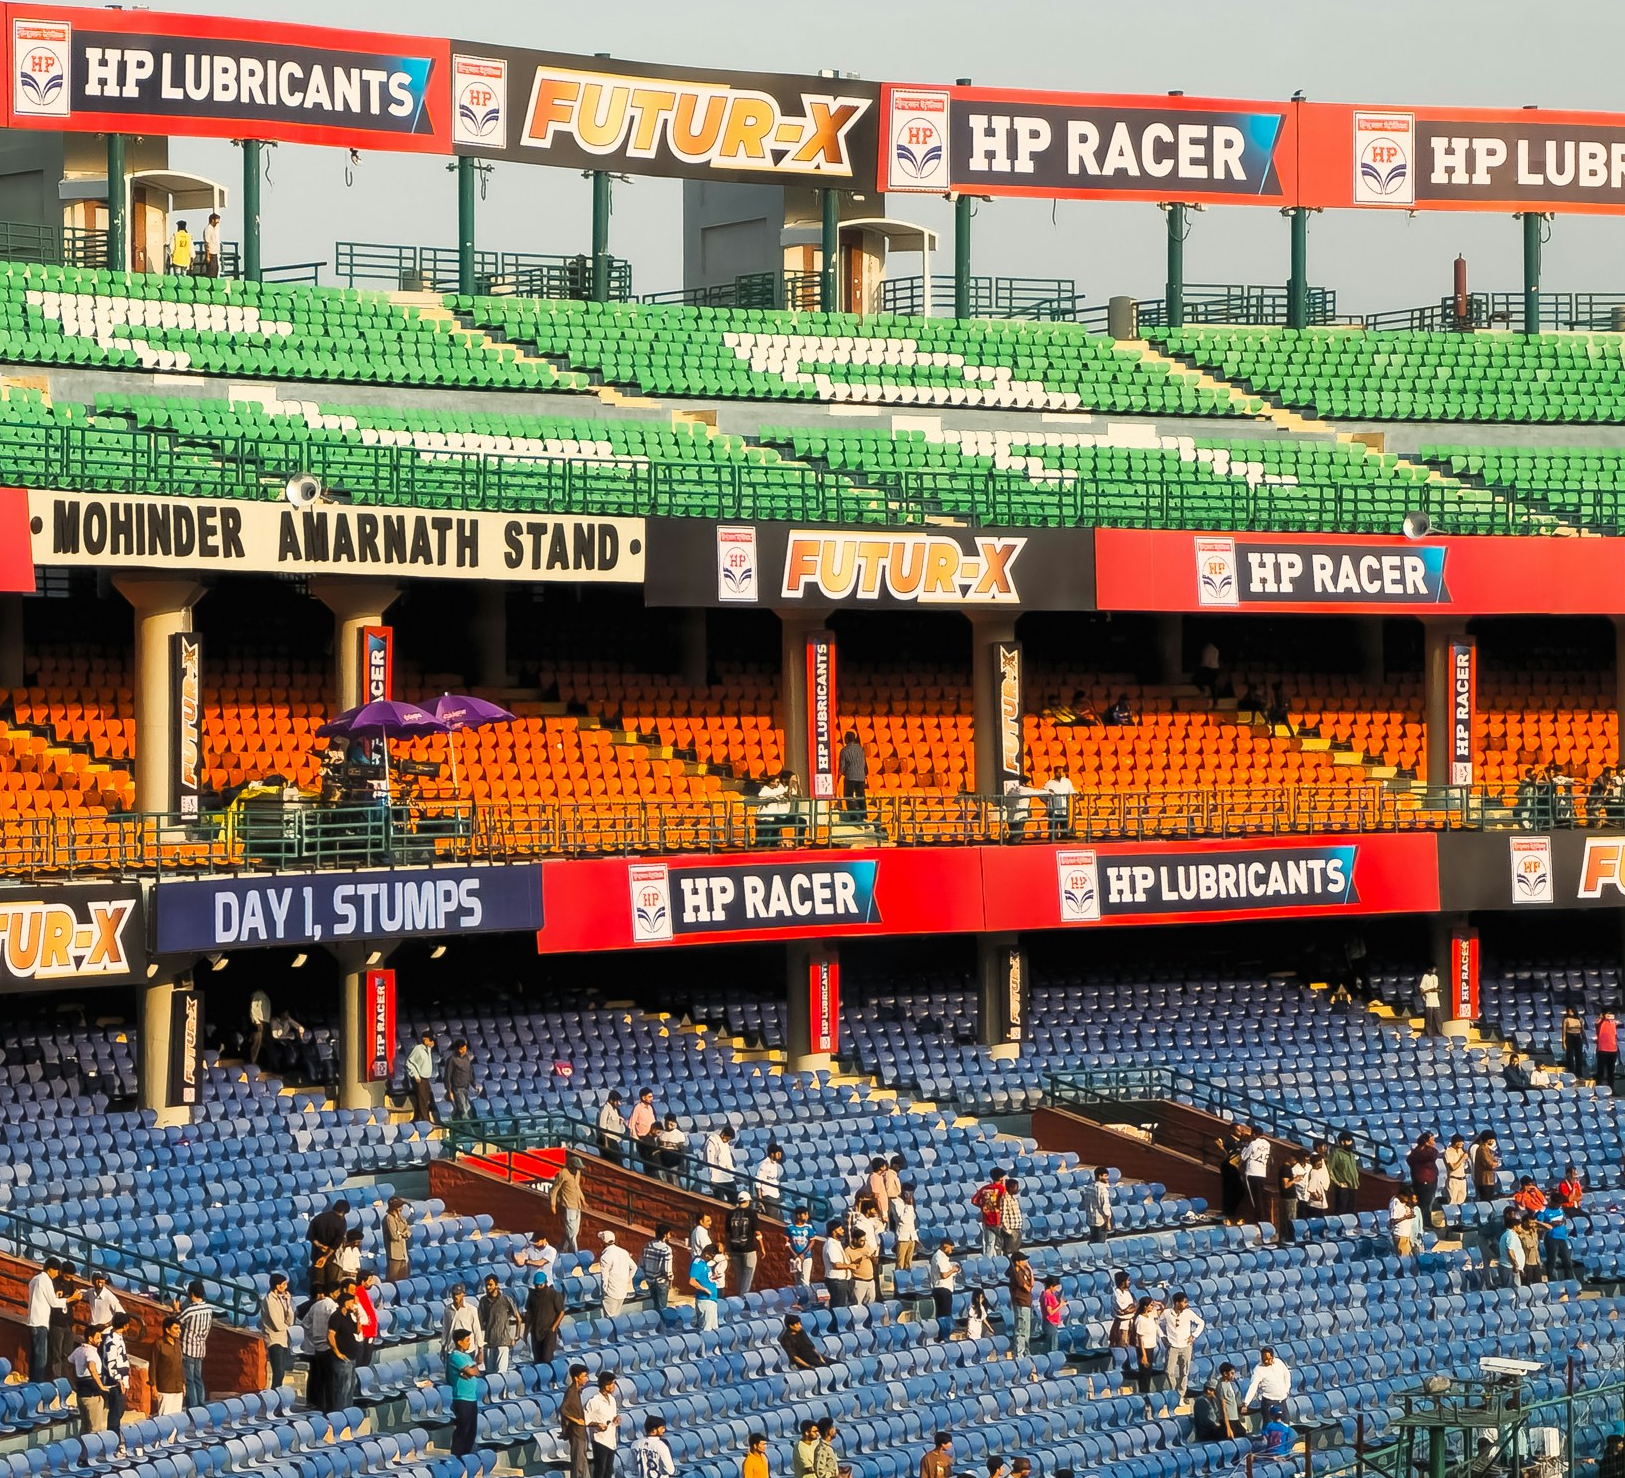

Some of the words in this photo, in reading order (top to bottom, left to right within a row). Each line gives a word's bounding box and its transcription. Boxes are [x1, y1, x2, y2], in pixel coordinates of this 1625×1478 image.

[31, 55, 55, 73] HP
[85, 47, 154, 98] HP
[161, 52, 414, 116] LUBRICANTS
[469, 89, 491, 107] HP
[525, 73, 865, 169] FUTUR-X
[908, 127, 933, 144] HP
[969, 114, 1051, 173] HP
[1067, 120, 1247, 181] RACER
[1430, 137, 1507, 186] HP
[53, 499, 245, 559] MOHINDER
[278, 510, 479, 568] AMARNATH
[504, 523, 619, 571] STAND
[784, 535, 1022, 598] FUTUR-X
[1248, 552, 1303, 593] HP
[1312, 554, 1428, 595] RACER
[182, 638, 198, 789] FUTUR-X
[815, 644, 827, 741] LUBRICANTS
[1456, 654, 1469, 719] RACER
[817, 743, 829, 770] HP
[1456, 724, 1469, 756] HP
[680, 876, 735, 923] HP
[744, 871, 859, 920] RACER
[1107, 865, 1155, 903] HP
[1159, 858, 1344, 902] LUBRICANTS
[215, 888, 293, 944] DAY
[333, 878, 482, 935] STUMPS
